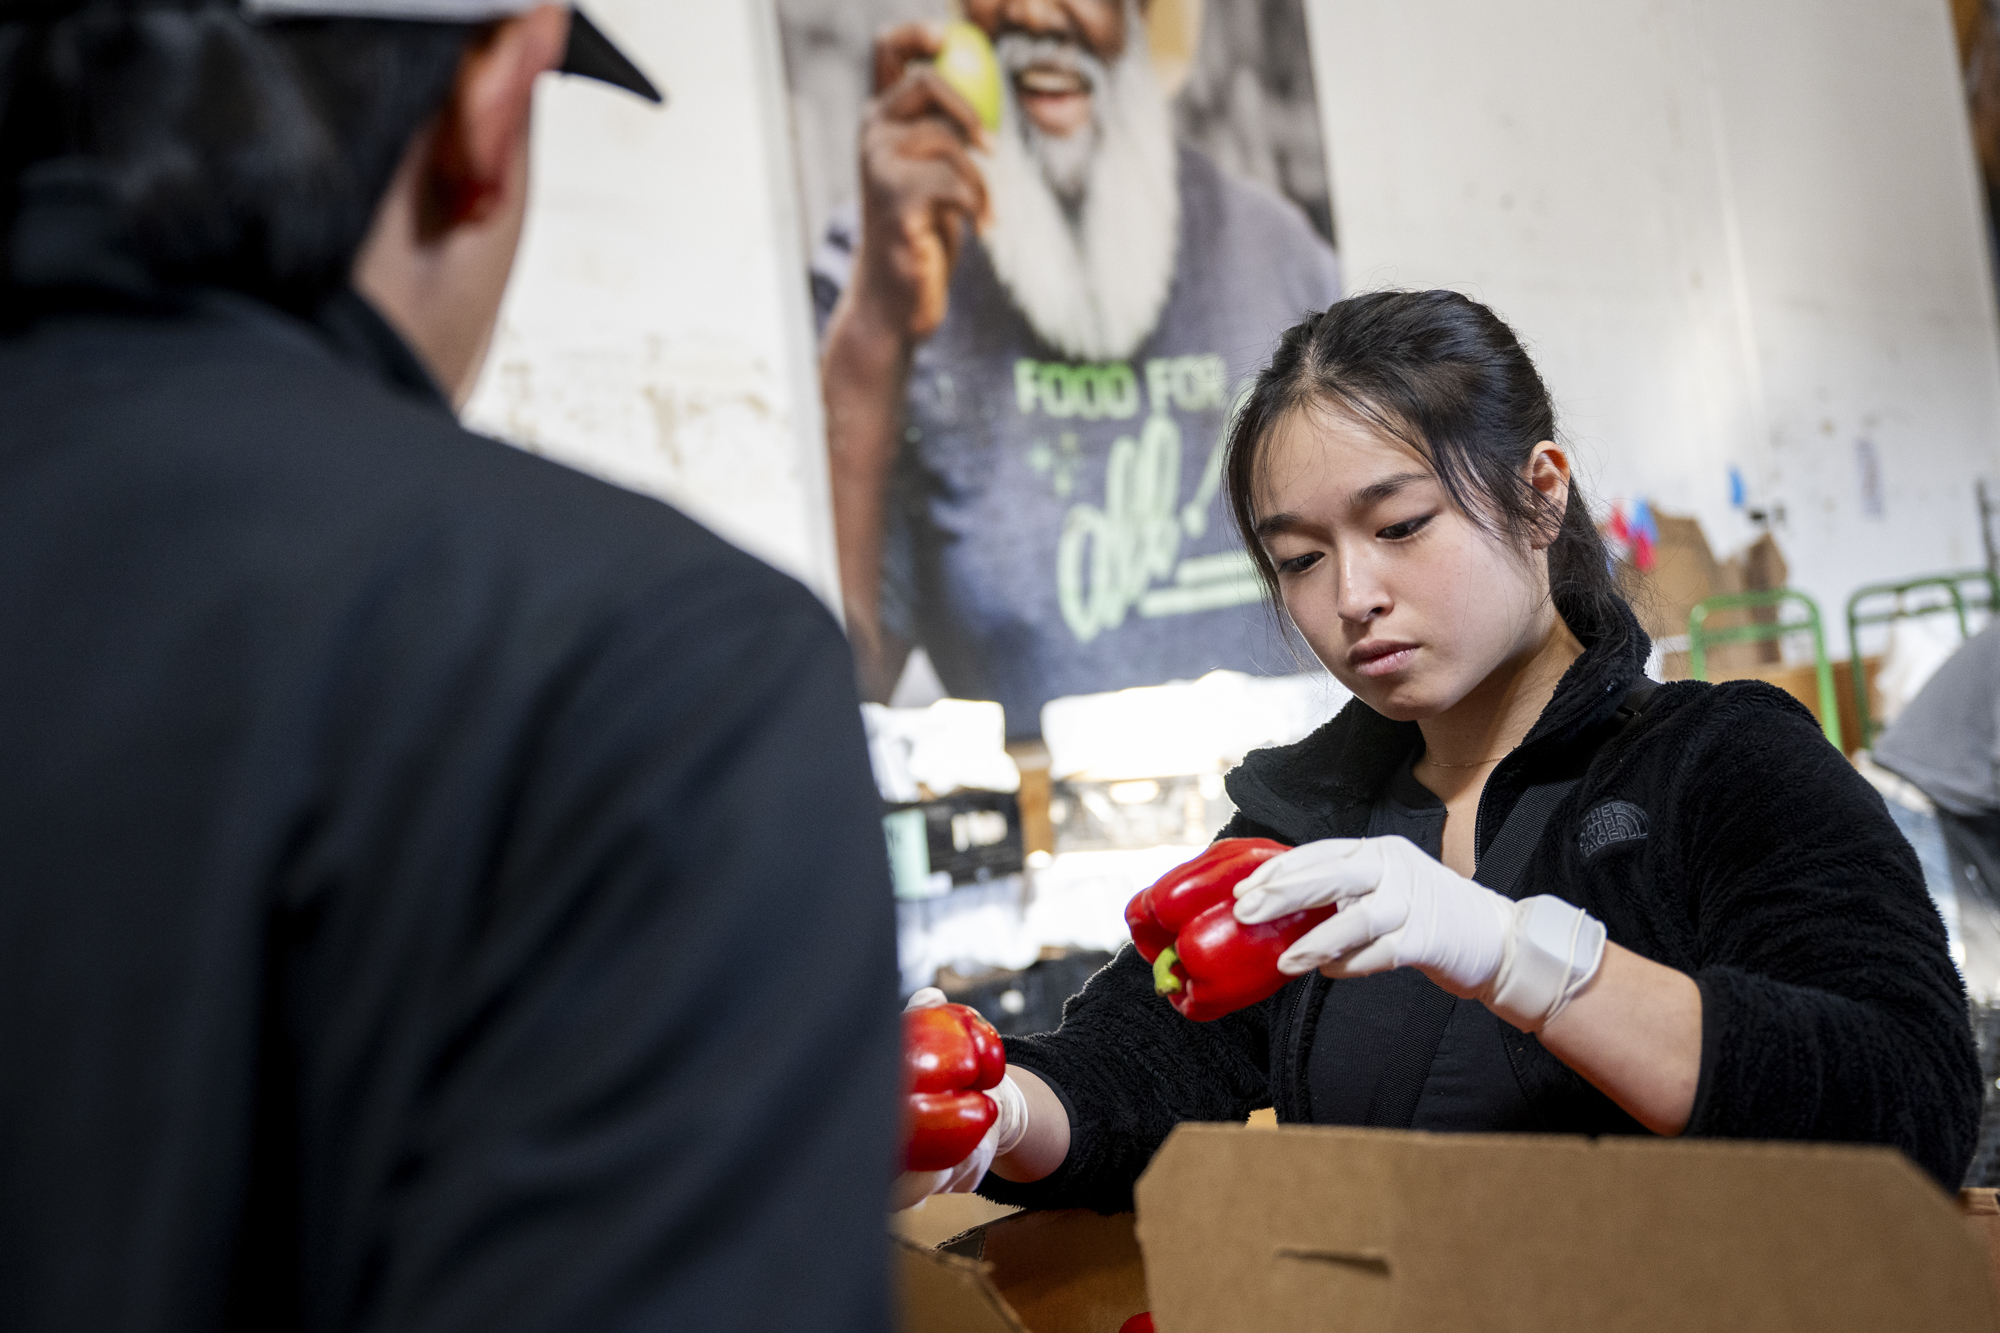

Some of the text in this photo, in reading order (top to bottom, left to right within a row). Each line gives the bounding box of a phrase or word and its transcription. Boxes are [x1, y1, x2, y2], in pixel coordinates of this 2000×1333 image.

[1014, 353, 1229, 420] FOOD FOR
[1580, 802, 1612, 824] THE
[1579, 815, 1616, 849] ORTH
[1581, 827, 1620, 858] FACE
